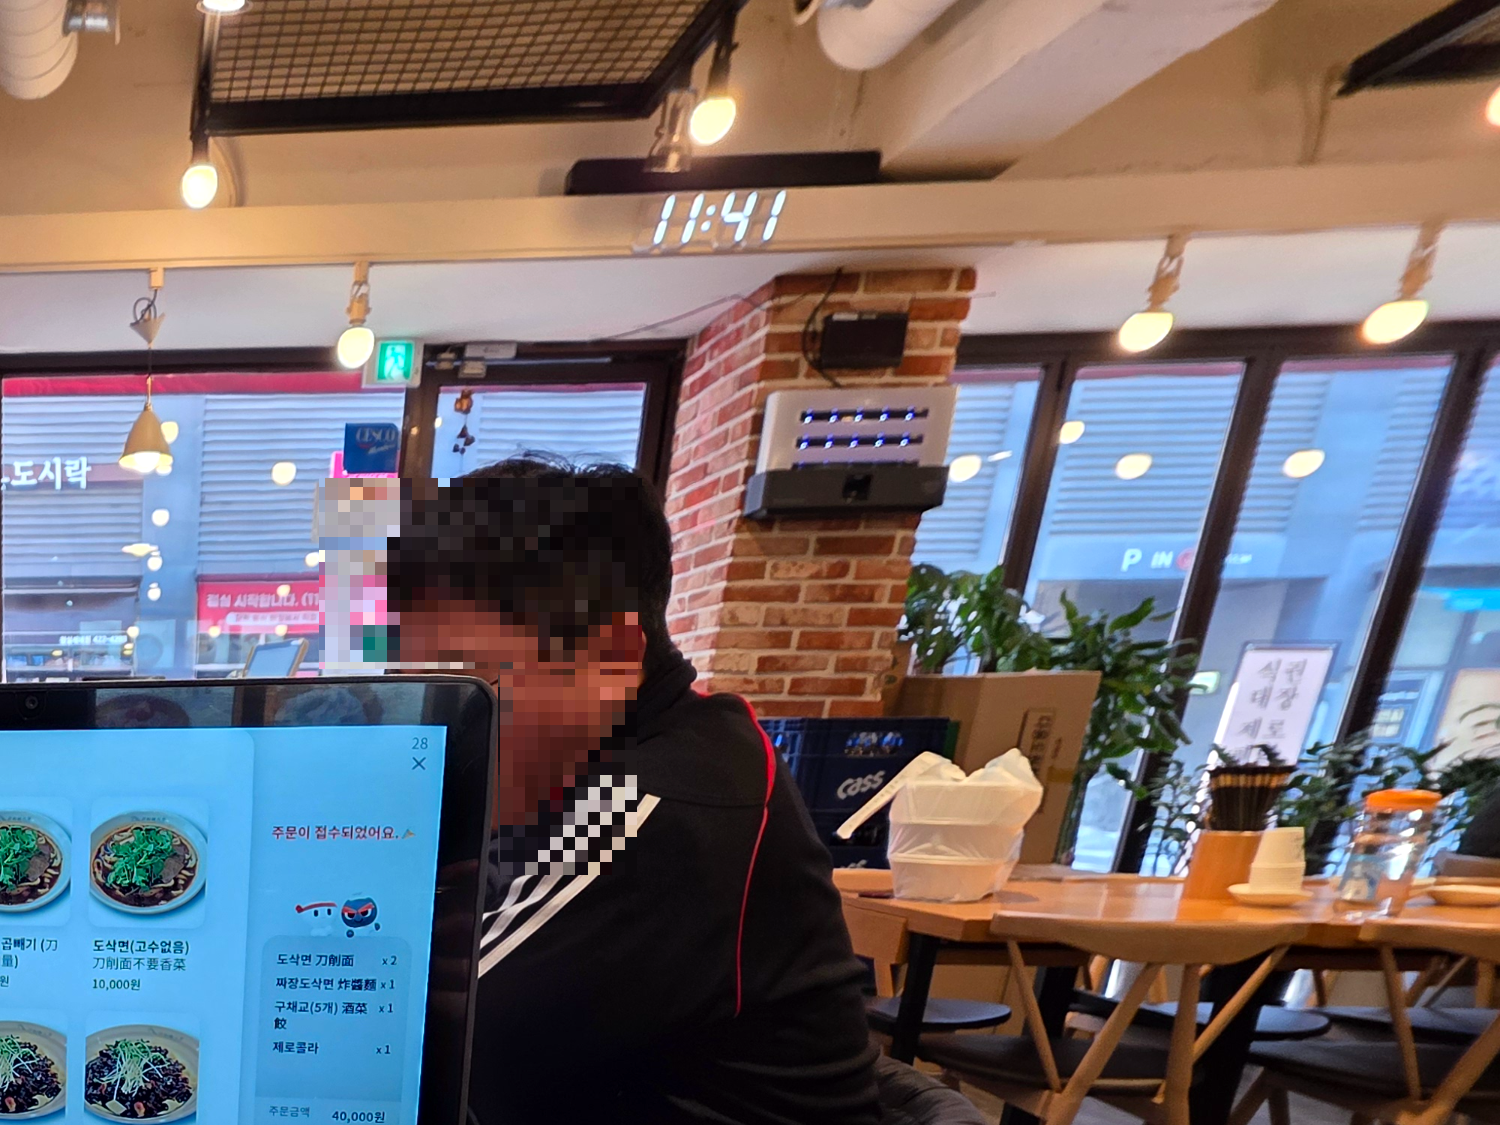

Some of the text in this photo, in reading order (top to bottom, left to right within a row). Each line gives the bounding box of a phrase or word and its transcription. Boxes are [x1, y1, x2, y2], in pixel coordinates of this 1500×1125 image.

[653, 190, 787, 245] 11:41
[1, 456, 92, 489] 도시락
[411, 737, 428, 750] 28
[272, 825, 399, 840] 주문이 접수되었어요.
[93, 940, 190, 955] 도삭면(고수없음)
[276, 954, 312, 966] 도삭면
[316, 954, 355, 967] 刀削面
[92, 979, 141, 991] 10,000원
[276, 977, 334, 990] 짜장도삭면
[274, 1001, 339, 1016] 구채교(5개)
[272, 1041, 319, 1055] 제로콜라
[269, 1106, 386, 1124] 주문금액 40,000원
